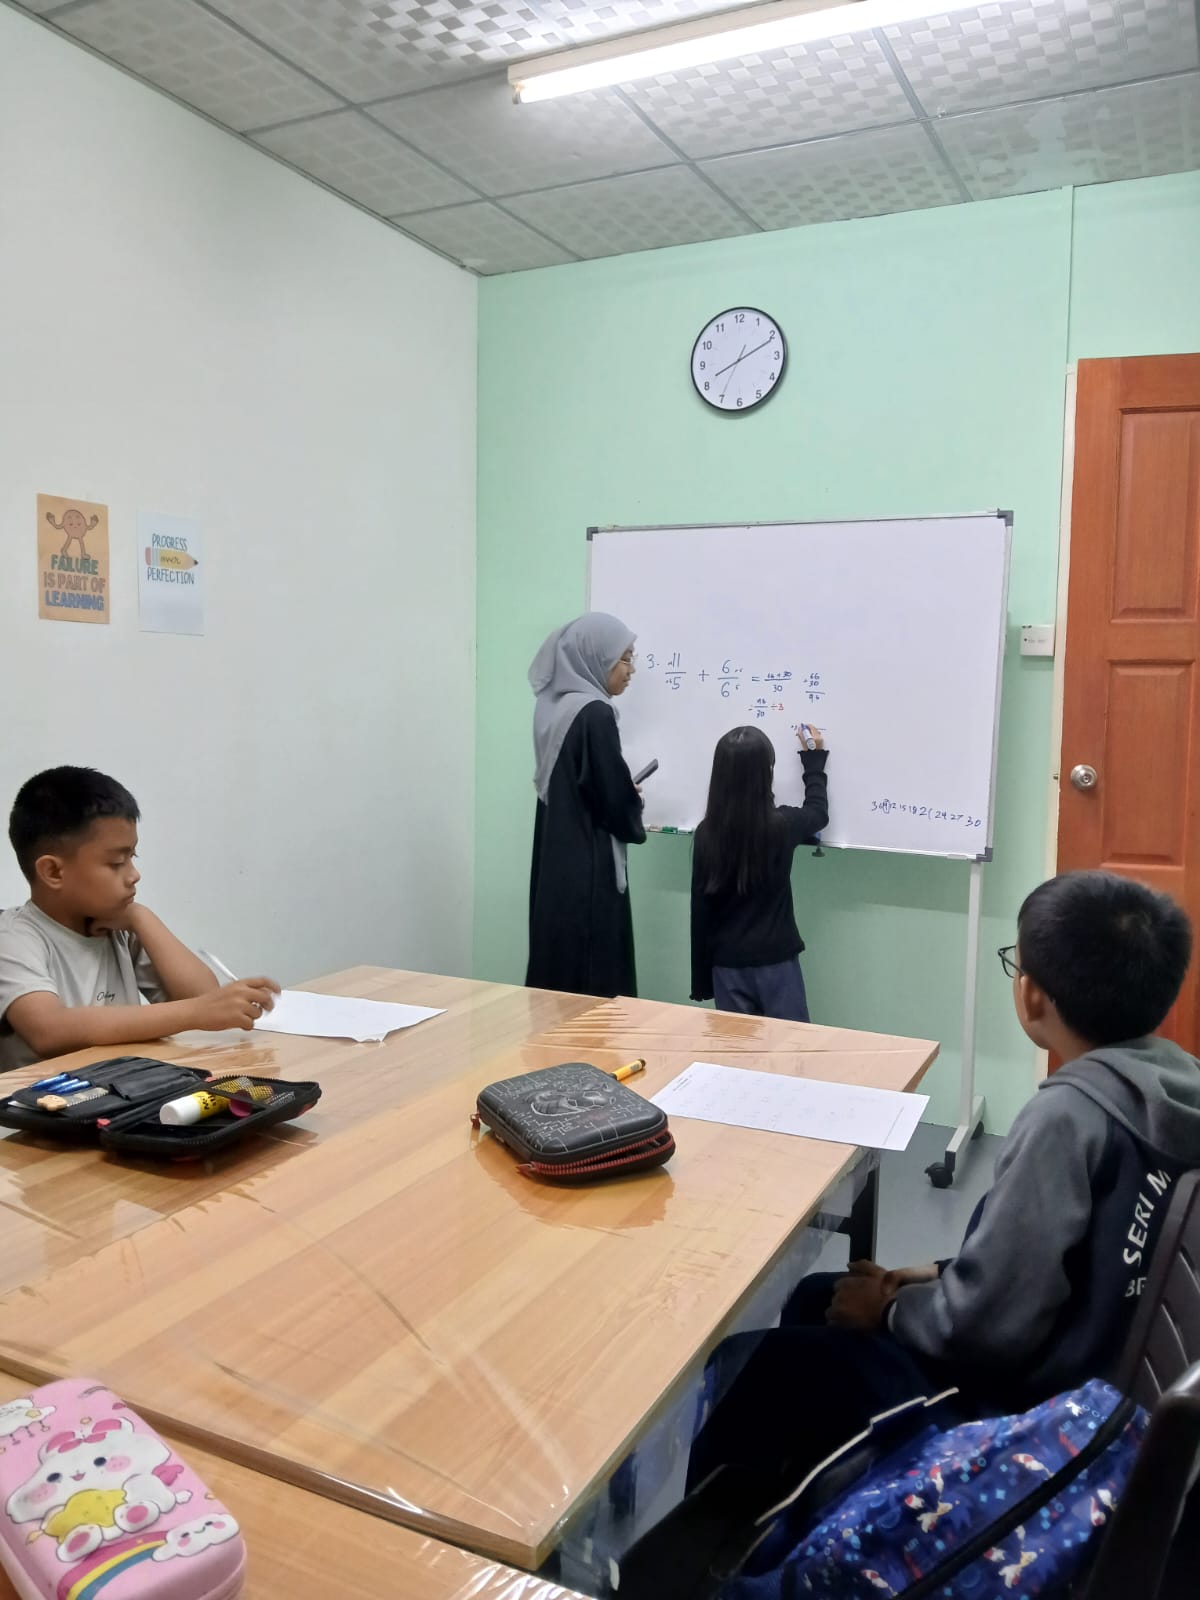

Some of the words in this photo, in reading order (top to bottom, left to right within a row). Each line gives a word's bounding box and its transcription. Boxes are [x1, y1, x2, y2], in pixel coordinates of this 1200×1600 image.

[734, 313, 745, 323] 12
[756, 317, 761, 327] 1
[715, 323, 725, 333] 11
[769, 330, 776, 340] 2
[702, 340, 713, 350] 10
[774, 351, 780, 360] 3
[700, 361, 706, 371] 9
[769, 372, 775, 381] 4
[704, 382, 710, 391] 8
[719, 394, 725, 403] 7
[756, 390, 762, 399] 5
[737, 398, 743, 407] 6
[152, 533, 188, 551] PROGRESS
[51, 554, 99, 575] FAILURE
[147, 566, 195, 584] PERFECTION
[44, 571, 56, 588] IS
[57, 573, 89, 592] PART
[91, 577, 106, 593] OF
[45, 590, 105, 611] LEARNING
[934, 810, 947, 820] 24
[964, 815, 982, 827] 30
[1123, 1191, 1155, 1268] SERI
